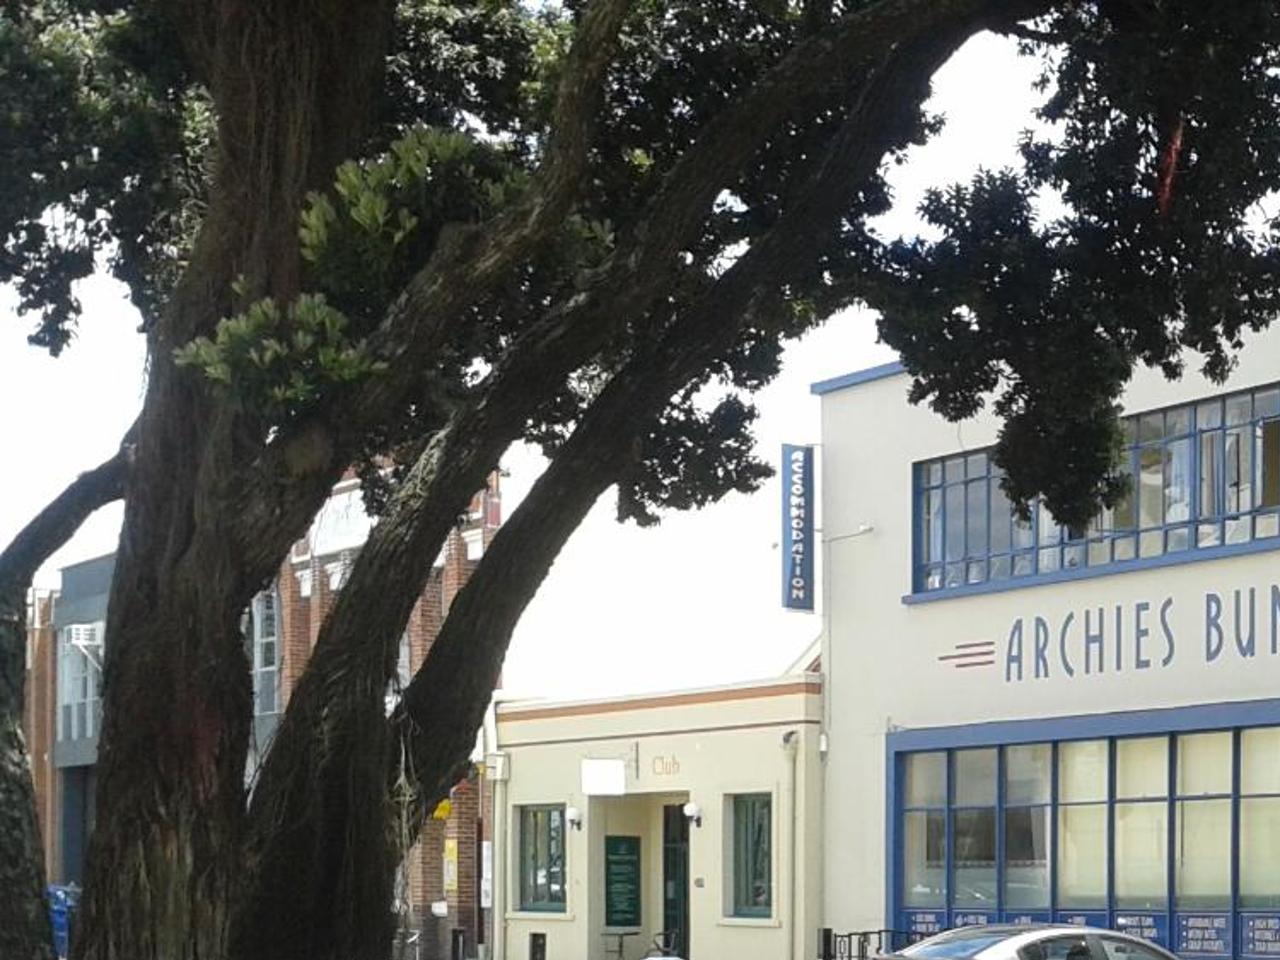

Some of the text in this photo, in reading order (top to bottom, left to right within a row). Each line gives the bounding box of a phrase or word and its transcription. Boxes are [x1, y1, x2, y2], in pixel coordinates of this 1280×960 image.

[791, 451, 804, 600] ACCOMMODATION
[1005, 597, 1175, 683] ARCHIES
[652, 752, 680, 776] Club
